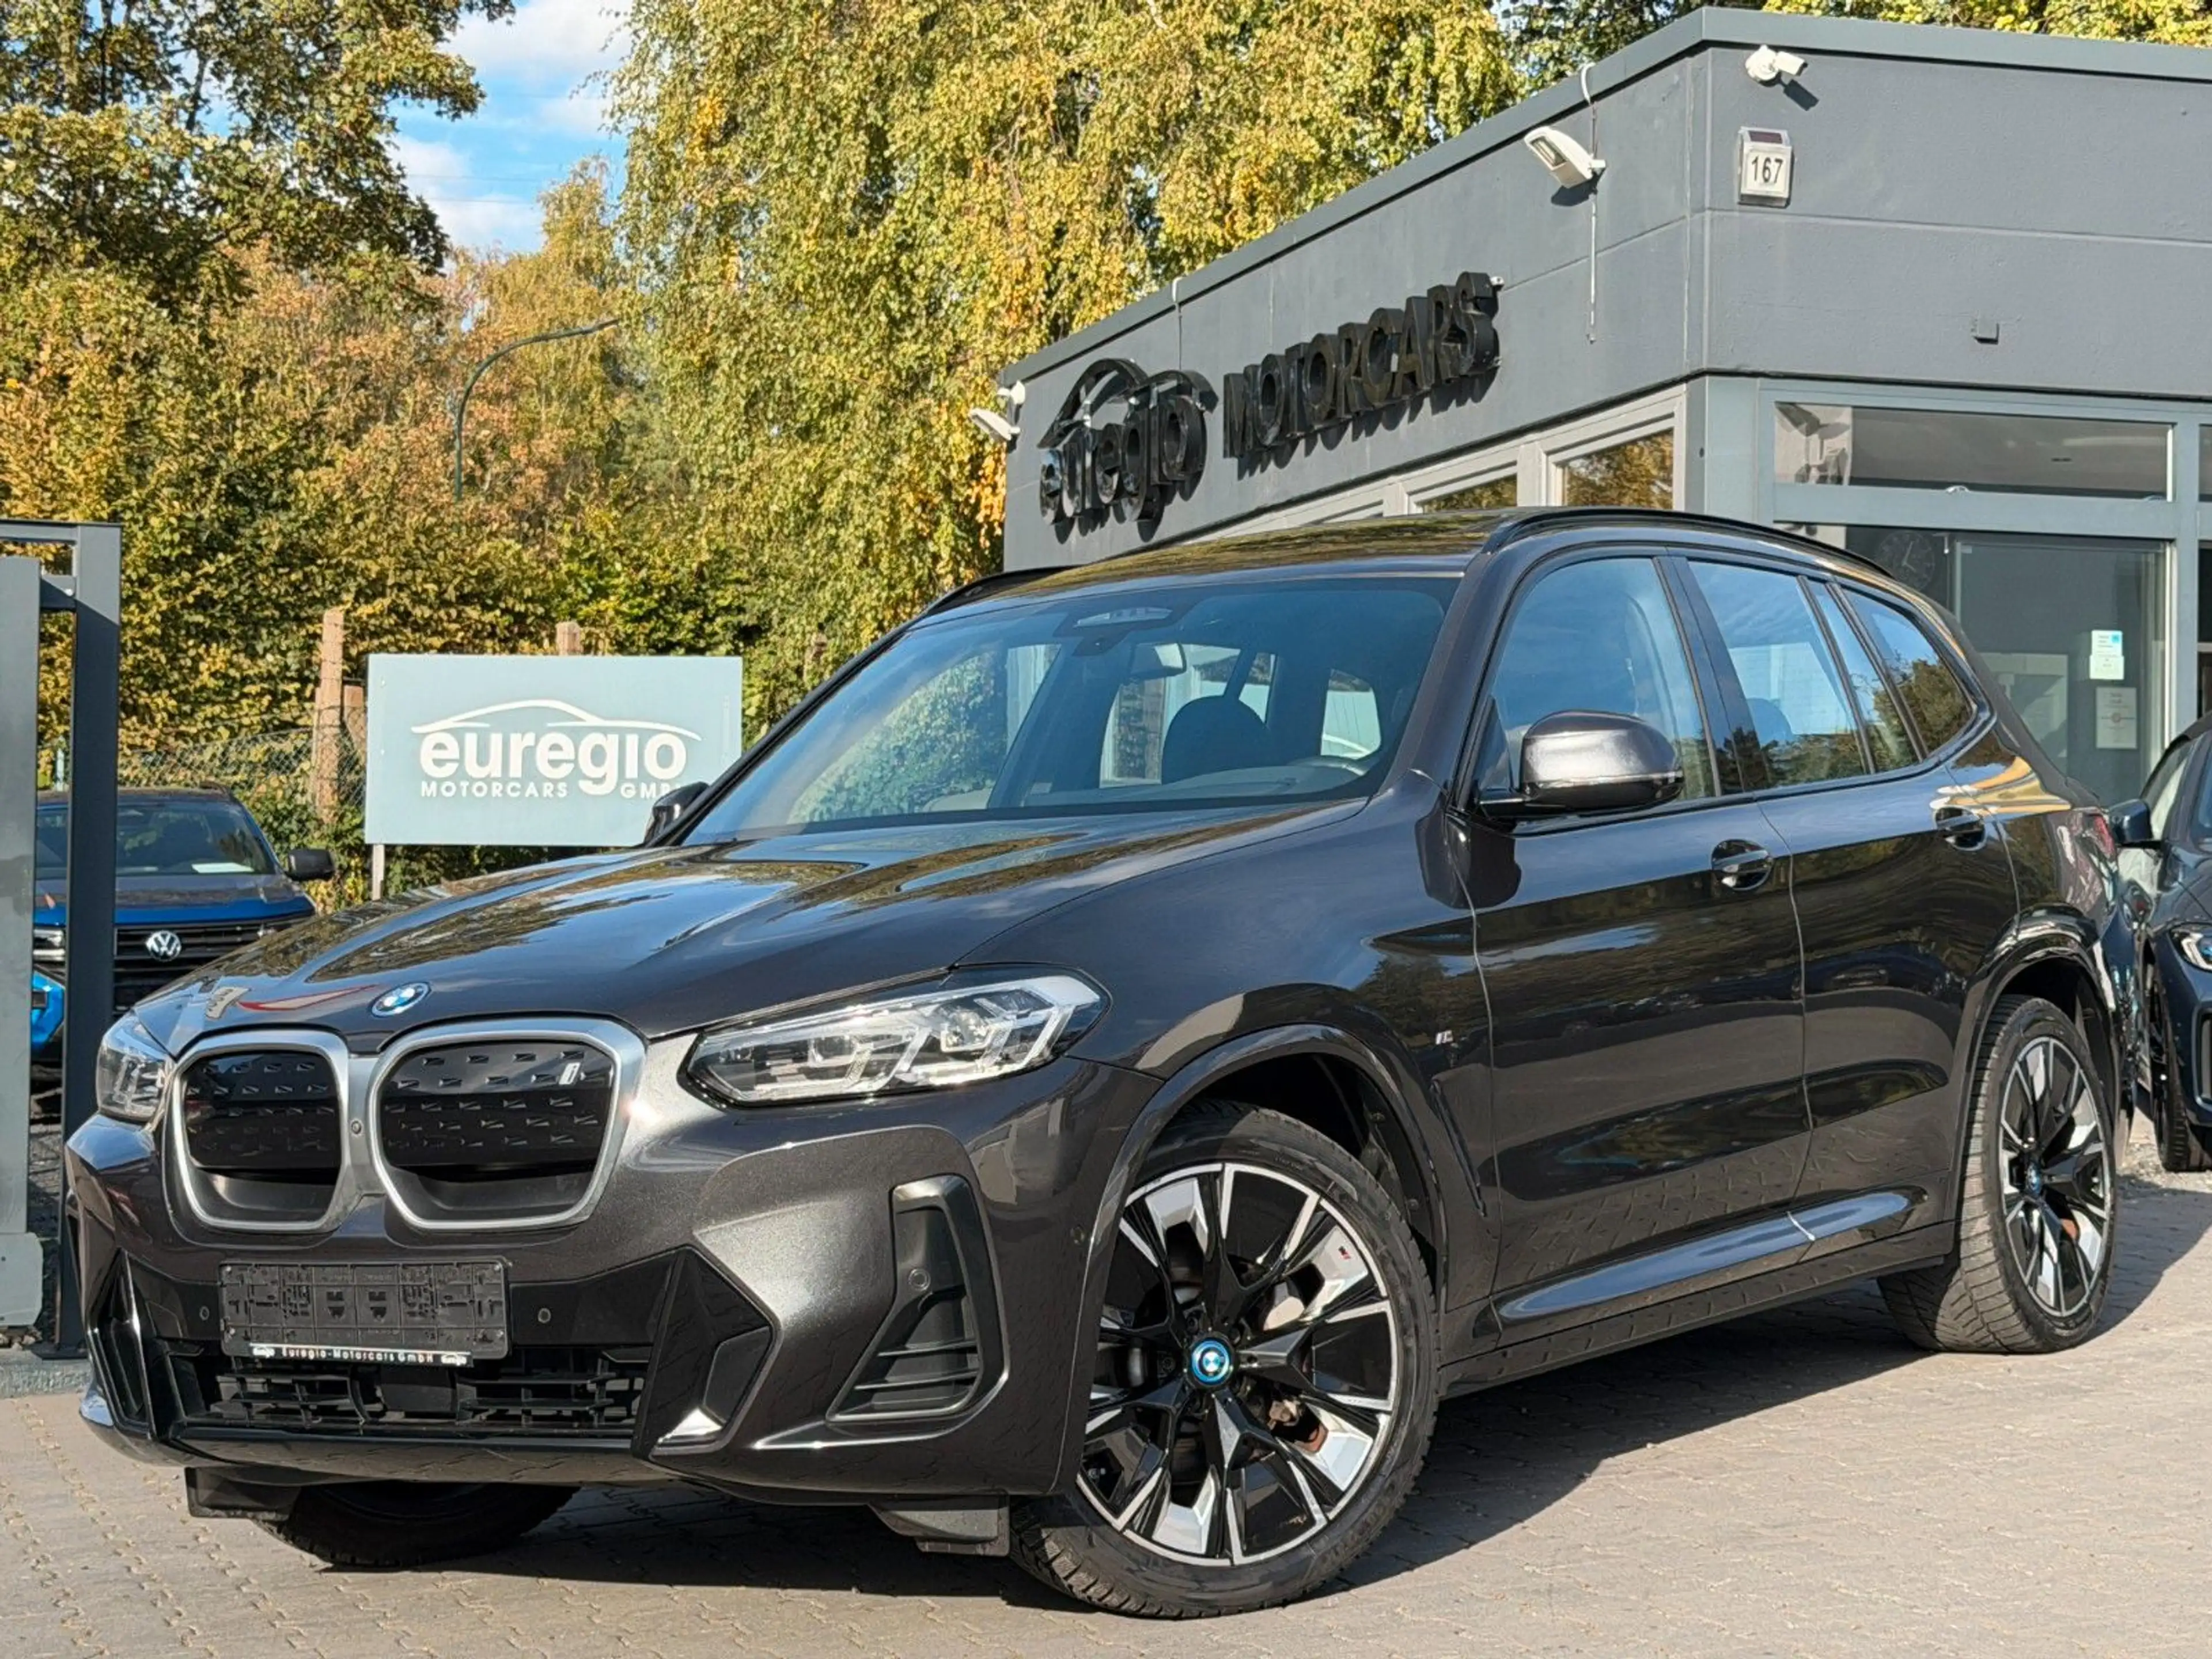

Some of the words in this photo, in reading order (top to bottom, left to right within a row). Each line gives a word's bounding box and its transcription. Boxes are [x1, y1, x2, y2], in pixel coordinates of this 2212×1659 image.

[1752, 156, 1783, 184] 167
[1223, 271, 1500, 459] MOTORCARS
[1039, 395, 1207, 525] euregio
[420, 732, 687, 796] euregio
[421, 781, 568, 798] MOTORCARS
[620, 782, 681, 798] GMB
